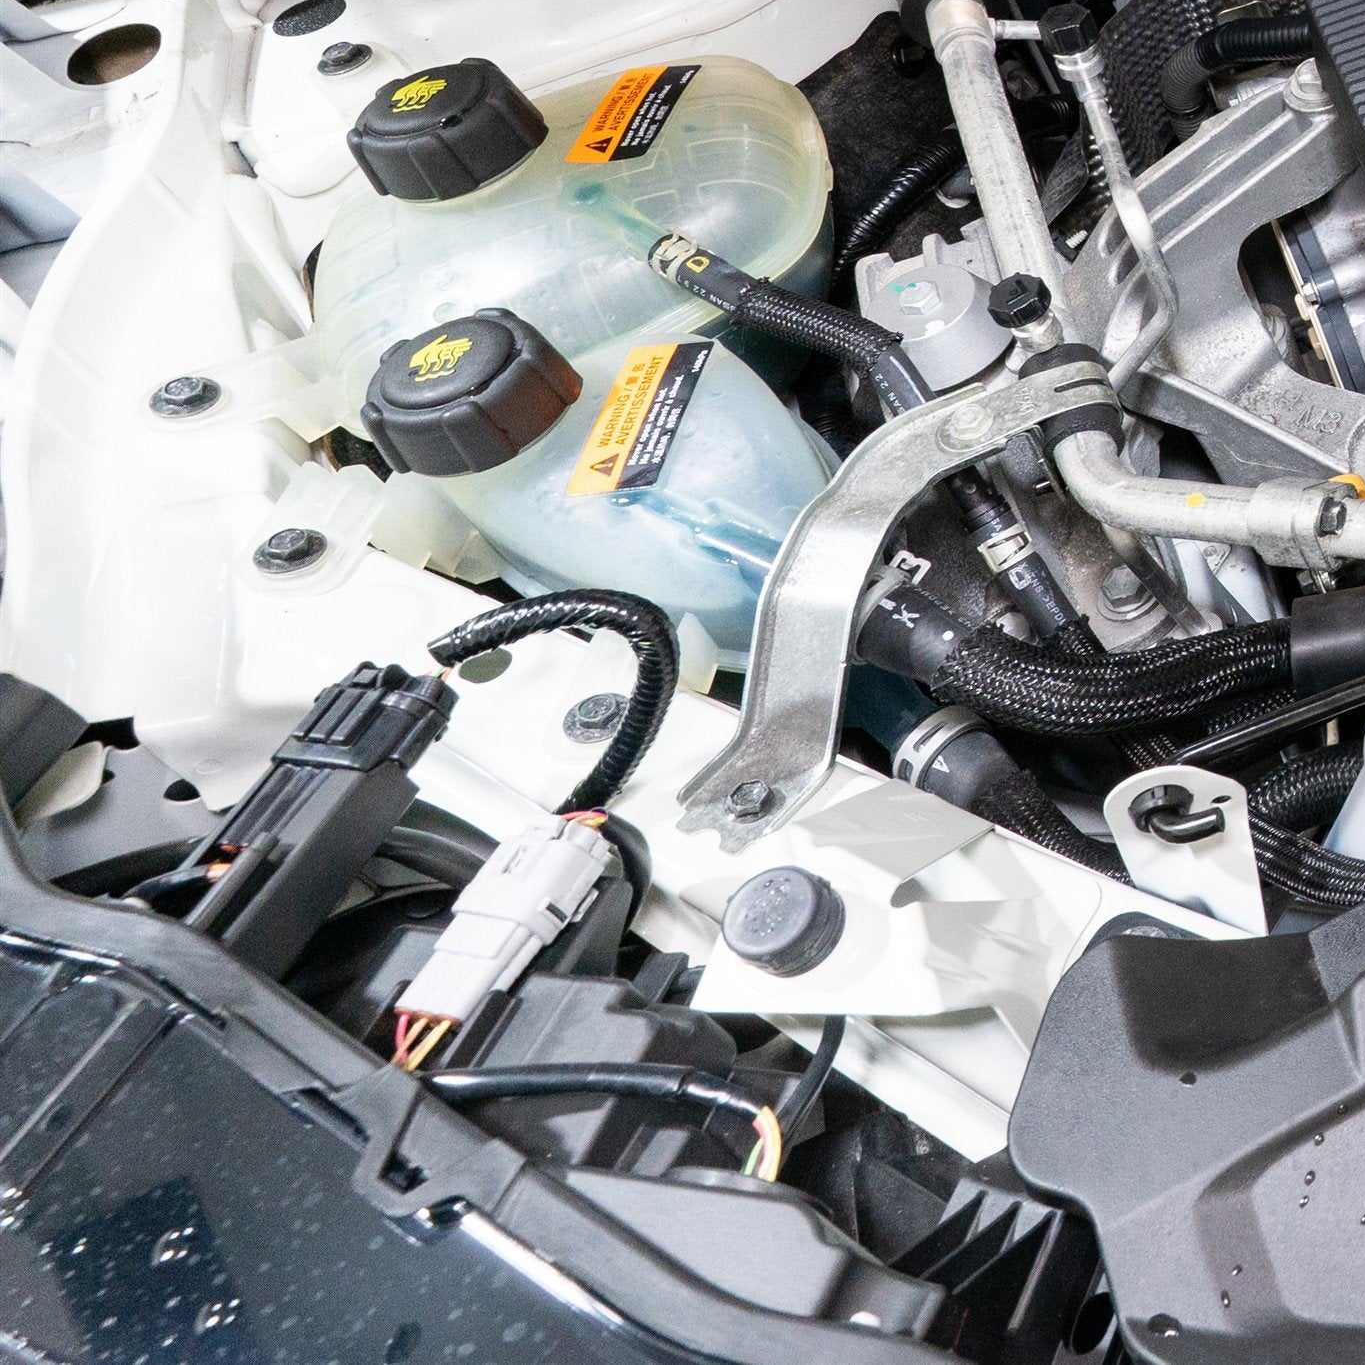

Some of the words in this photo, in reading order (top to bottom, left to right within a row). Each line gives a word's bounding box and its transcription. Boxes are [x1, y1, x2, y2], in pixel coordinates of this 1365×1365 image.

[593, 96, 622, 132] WARNING
[609, 73, 654, 131] AVERTISSEMENT
[614, 356, 664, 445] AVERTISSEMENT
[875, 373, 889, 389] 22
[598, 395, 630, 447] WARNING
